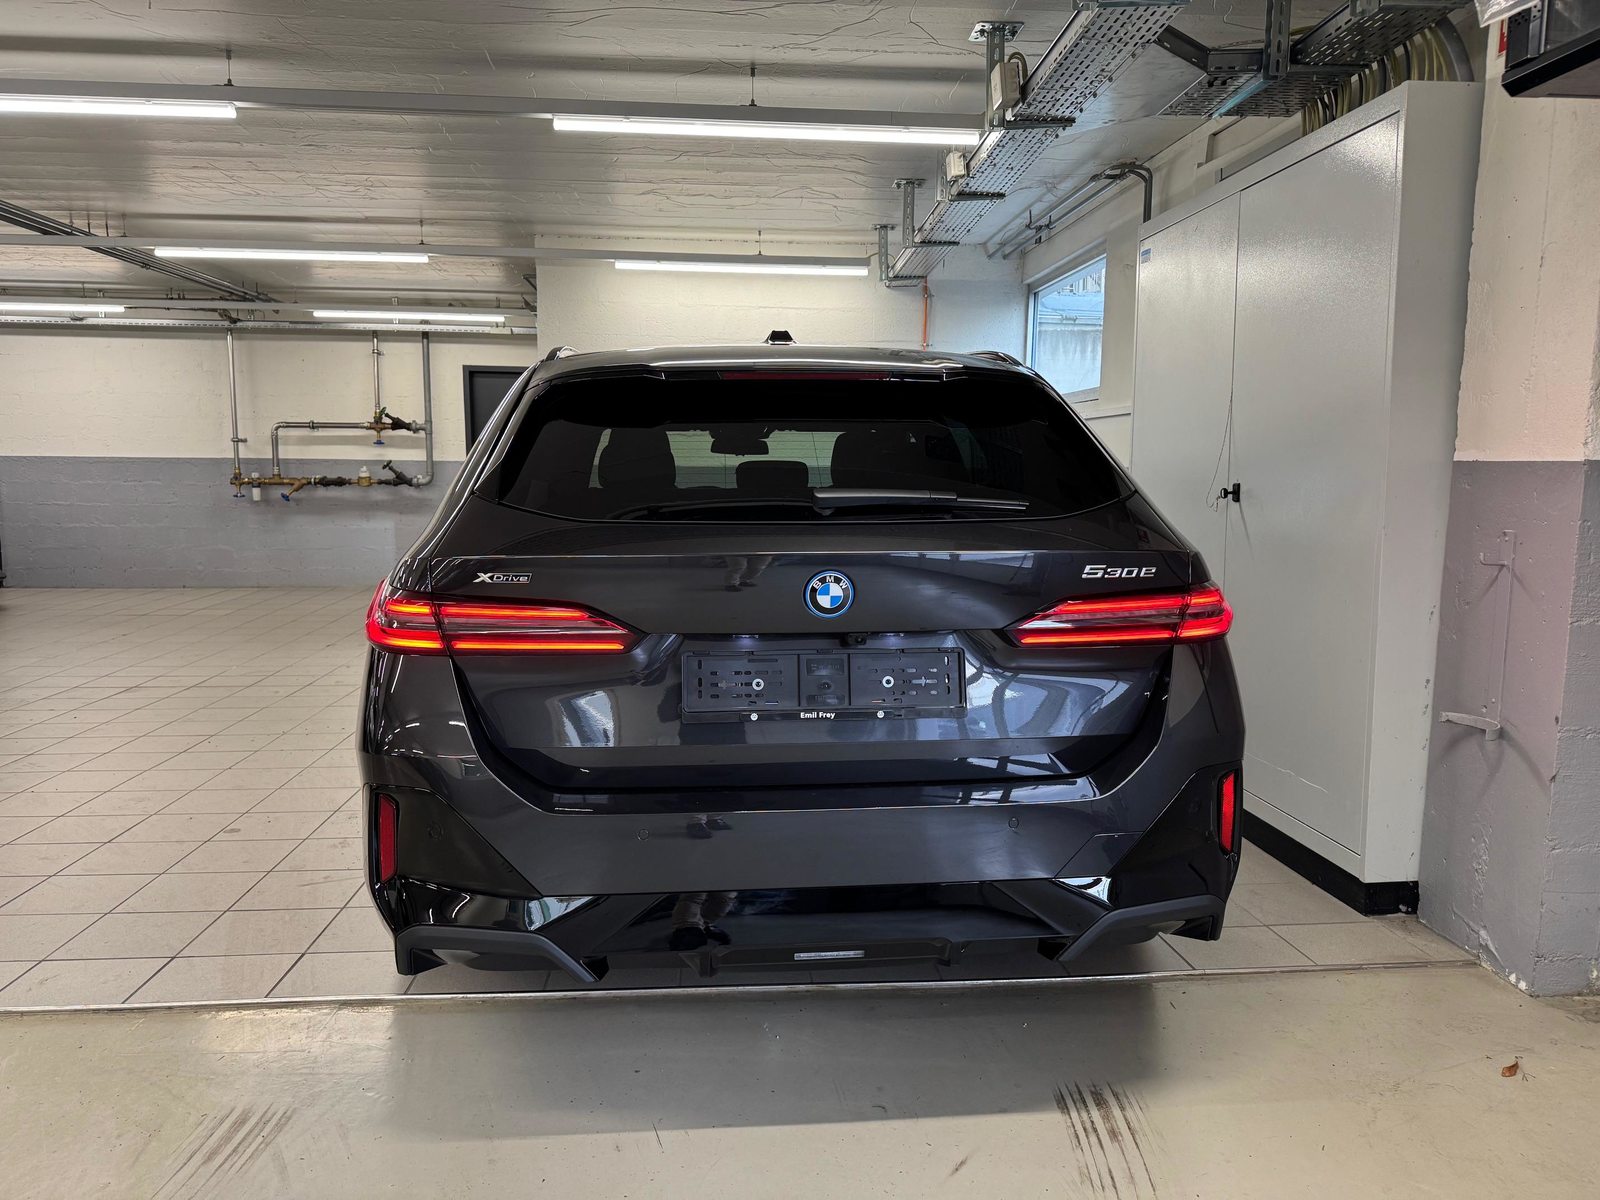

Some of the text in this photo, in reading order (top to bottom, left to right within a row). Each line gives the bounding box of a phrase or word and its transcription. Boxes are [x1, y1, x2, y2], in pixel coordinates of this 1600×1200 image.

[1081, 564, 1157, 579] 530e
[812, 575, 849, 590] BMW
[800, 711, 836, 720] Emil Frey
